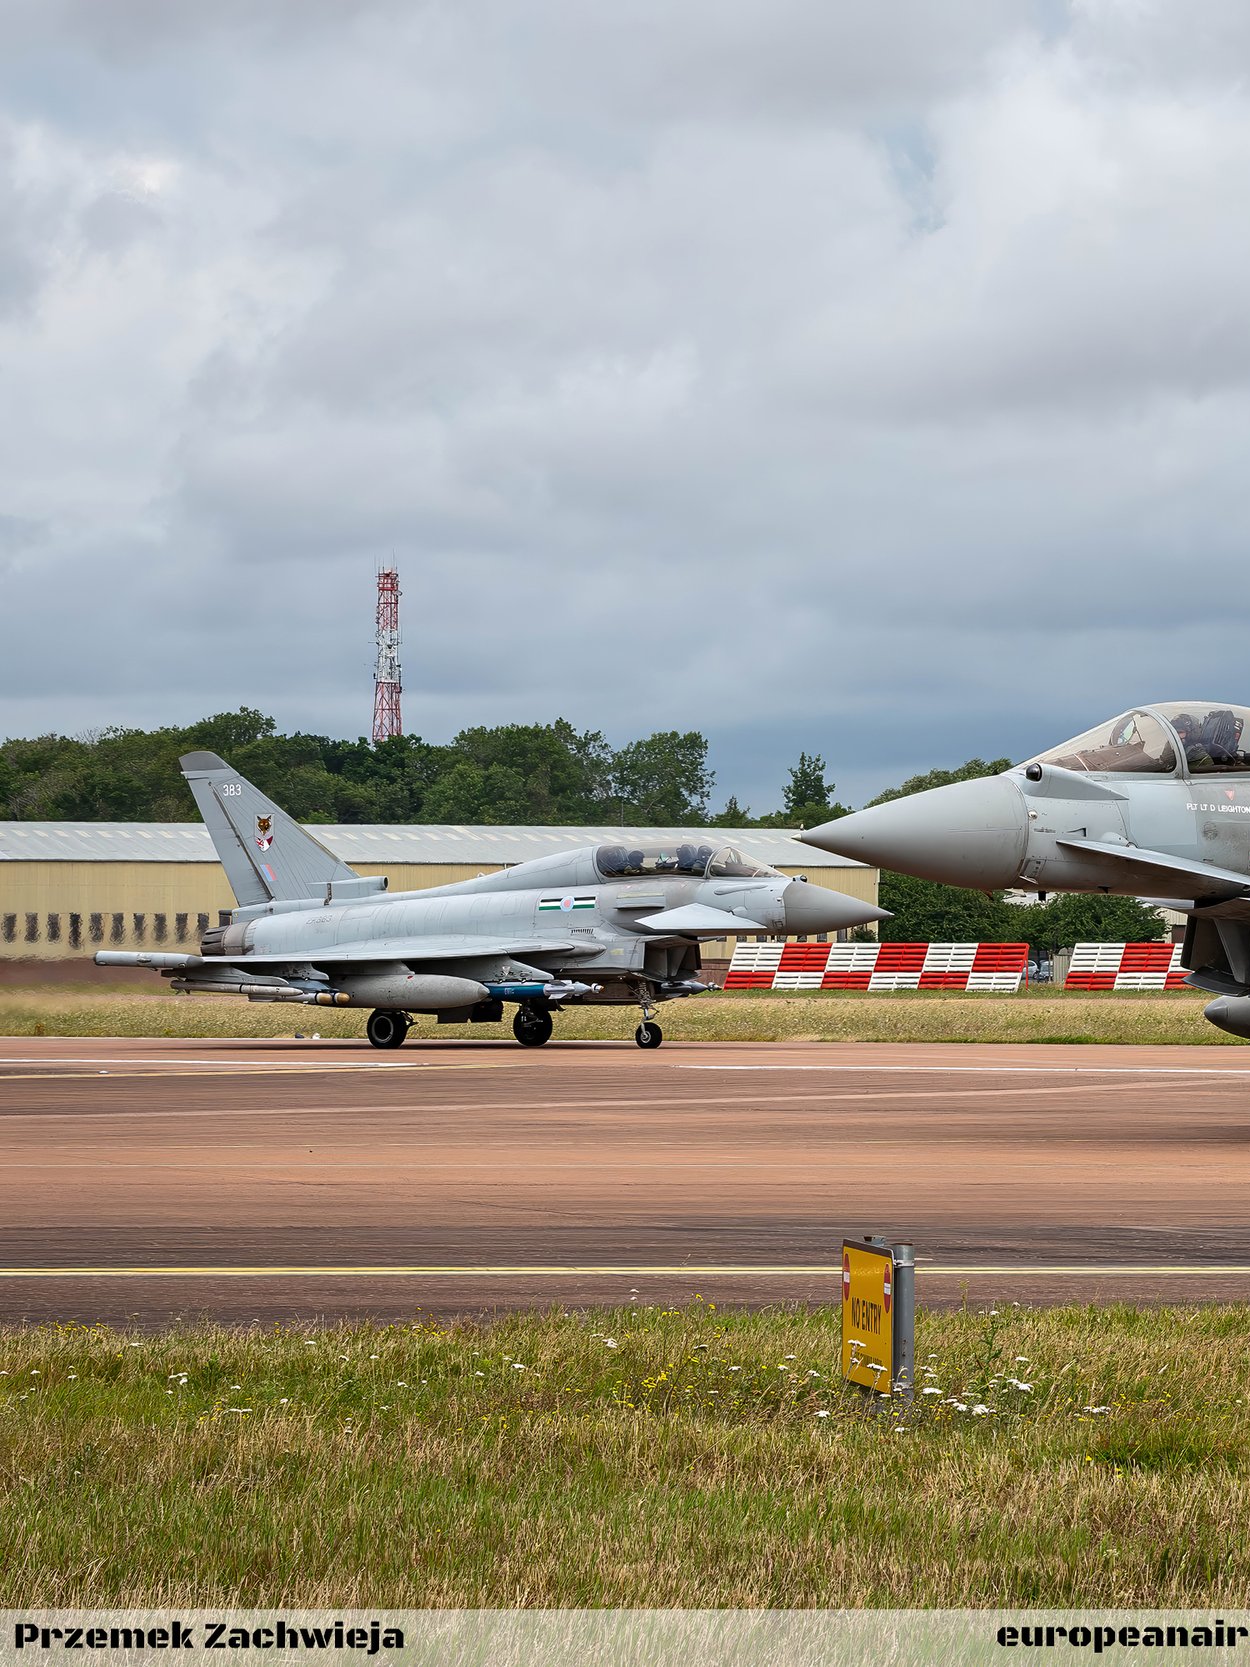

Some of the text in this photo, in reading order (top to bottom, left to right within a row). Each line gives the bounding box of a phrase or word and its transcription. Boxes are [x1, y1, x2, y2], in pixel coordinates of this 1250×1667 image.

[223, 783, 242, 797] 383
[1200, 803, 1208, 811] LT
[1209, 803, 1216, 812] D
[851, 1296, 882, 1335] NO ENTRY
